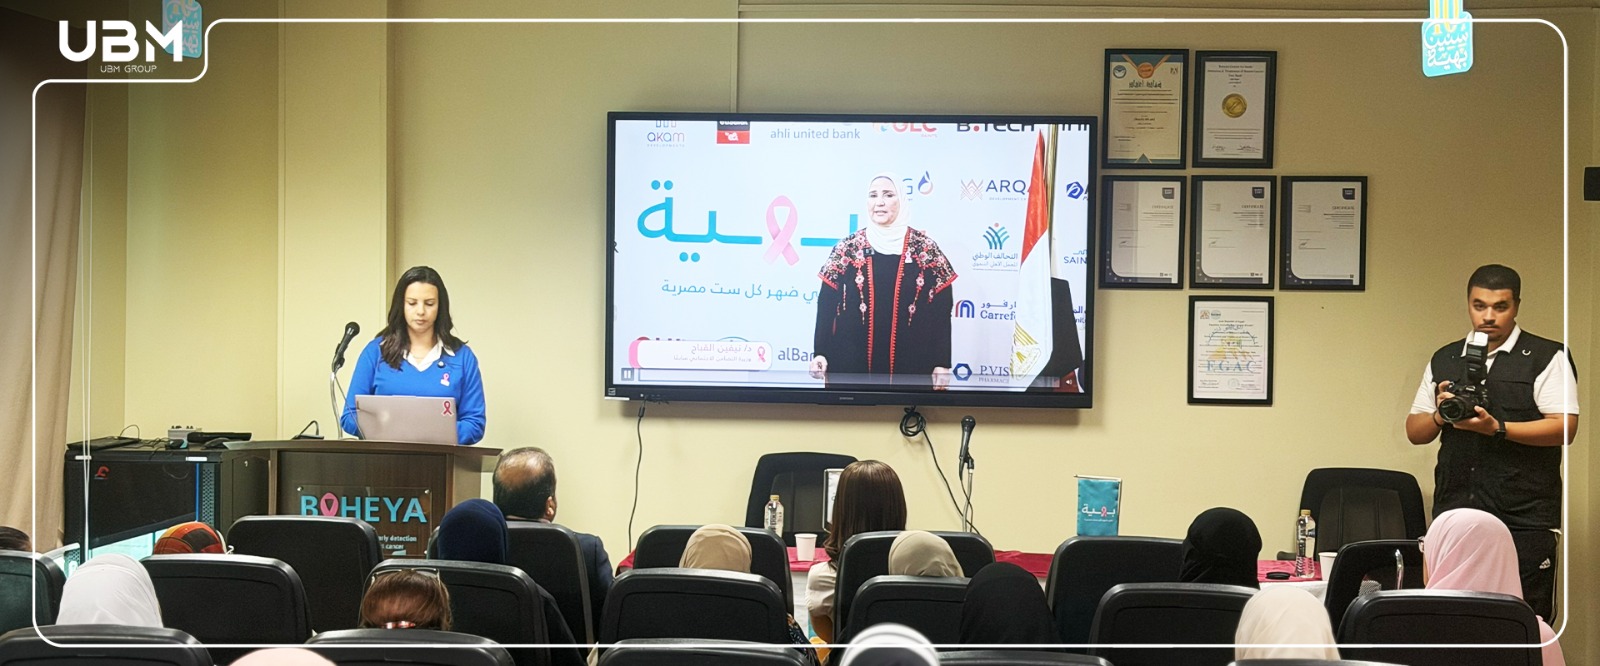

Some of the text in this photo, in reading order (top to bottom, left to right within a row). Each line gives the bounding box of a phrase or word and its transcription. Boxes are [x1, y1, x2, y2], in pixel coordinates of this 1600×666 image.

[647, 131, 685, 143] akam
[770, 128, 861, 140] ahli united bank
[985, 179, 1028, 195] ARQ
[661, 279, 706, 297] مصرية
[710, 283, 740, 296] ست
[745, 283, 762, 299] كل
